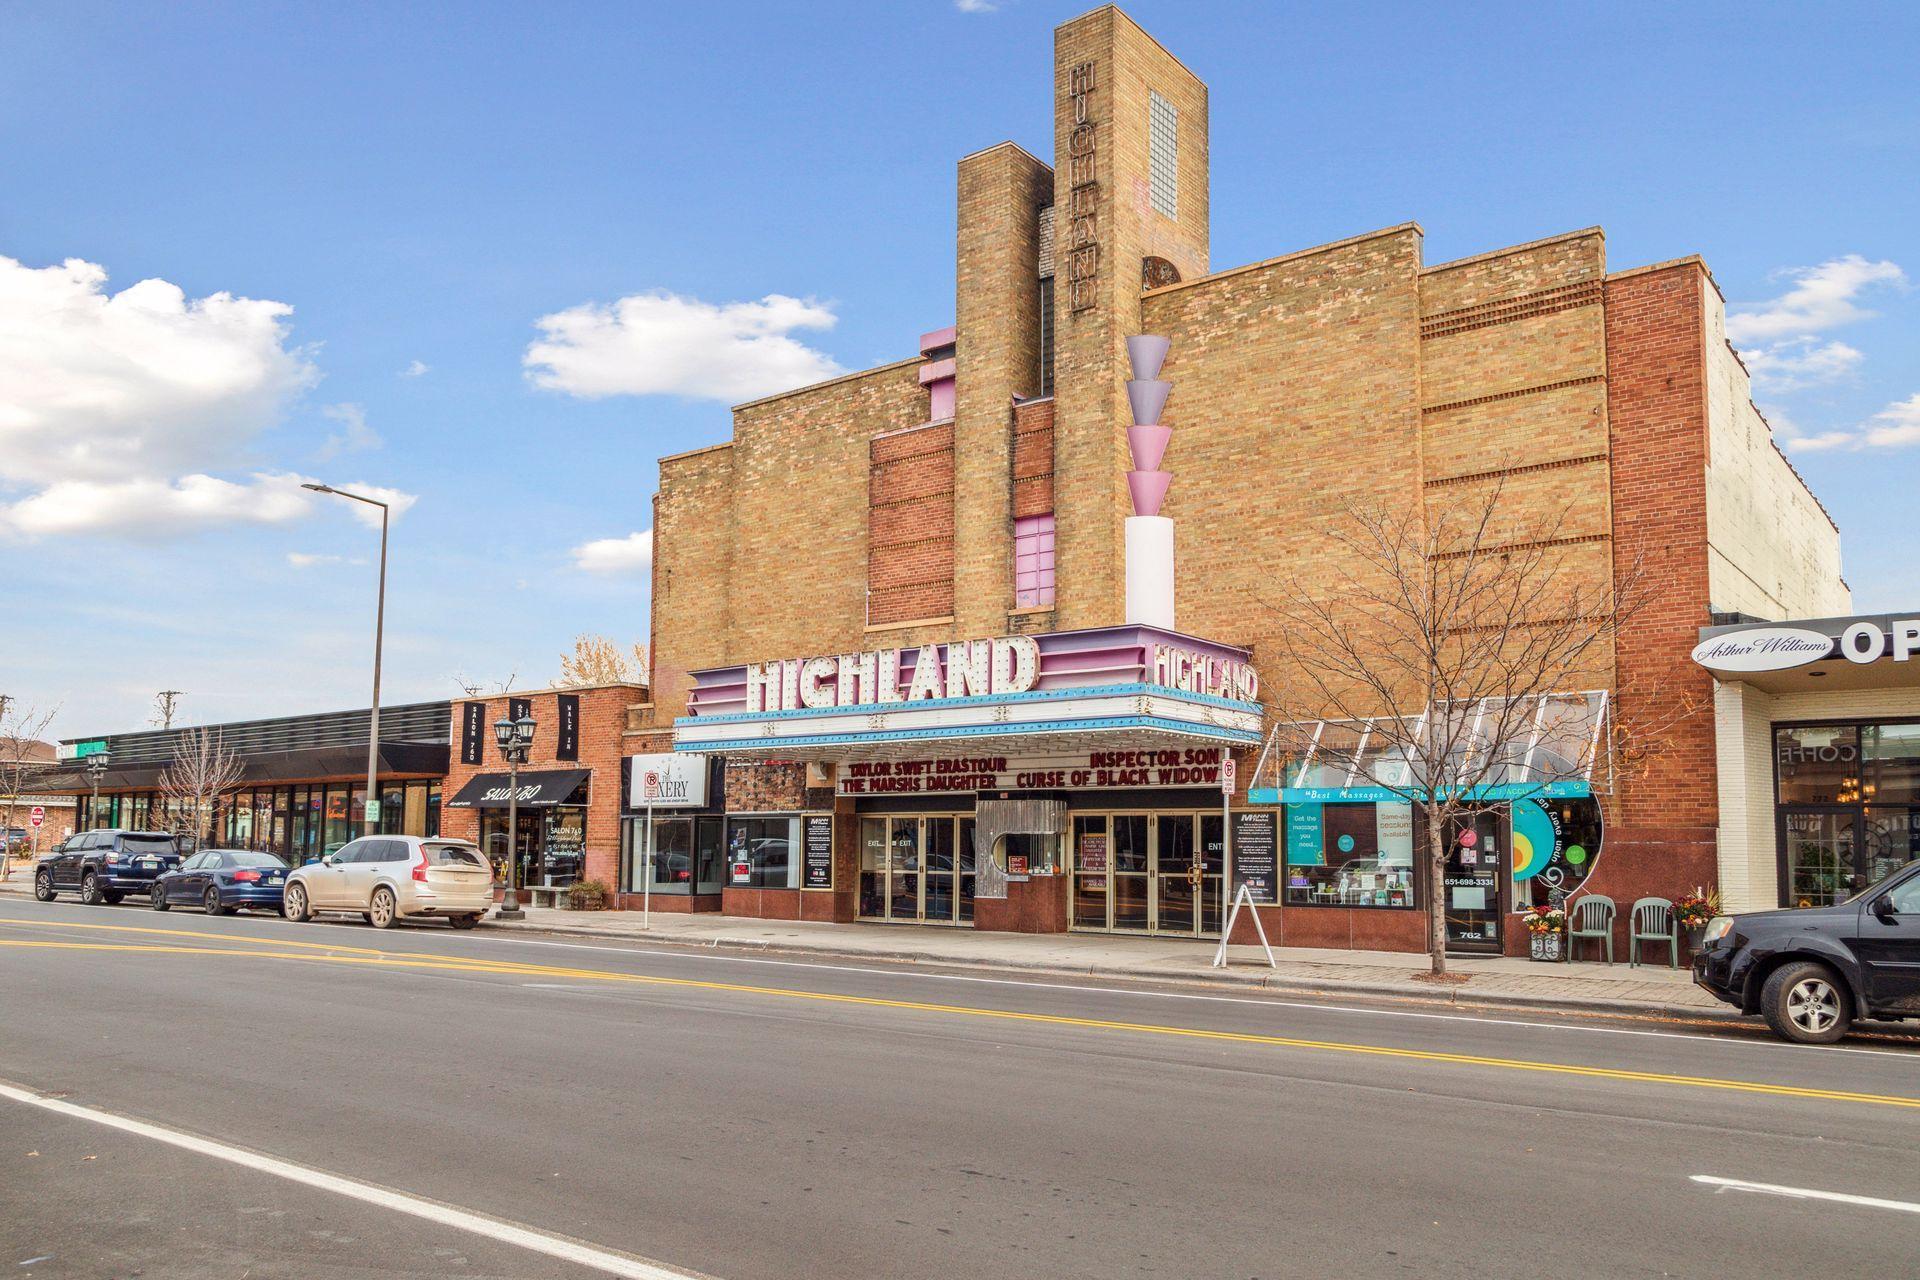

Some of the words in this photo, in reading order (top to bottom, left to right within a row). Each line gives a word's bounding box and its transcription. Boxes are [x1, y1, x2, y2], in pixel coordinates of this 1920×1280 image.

[1068, 61, 1098, 313] HIGHLAND
[1697, 642, 1755, 661] Arthur
[1753, 636, 1829, 653] Williams
[747, 634, 1041, 713] HIGHLAND
[1153, 643, 1258, 703] HIGHLAND
[849, 762, 891, 777] TAYLOR
[894, 760, 933, 775] SWIFT
[1090, 750, 1180, 769] INSPECTOR
[1184, 748, 1219, 765] SON
[842, 778, 866, 792] THE
[869, 777, 921, 792] MARSHS
[926, 774, 997, 790] DAUGHTER
[1017, 771, 1065, 788] CURSE
[1071, 770, 1091, 786] OF
[1097, 769, 1150, 786] BLACK
[1158, 767, 1219, 785] WIDOW
[1548, 811, 1562, 836] every
[1551, 840, 1562, 863] open
[1459, 931, 1481, 940] 762
